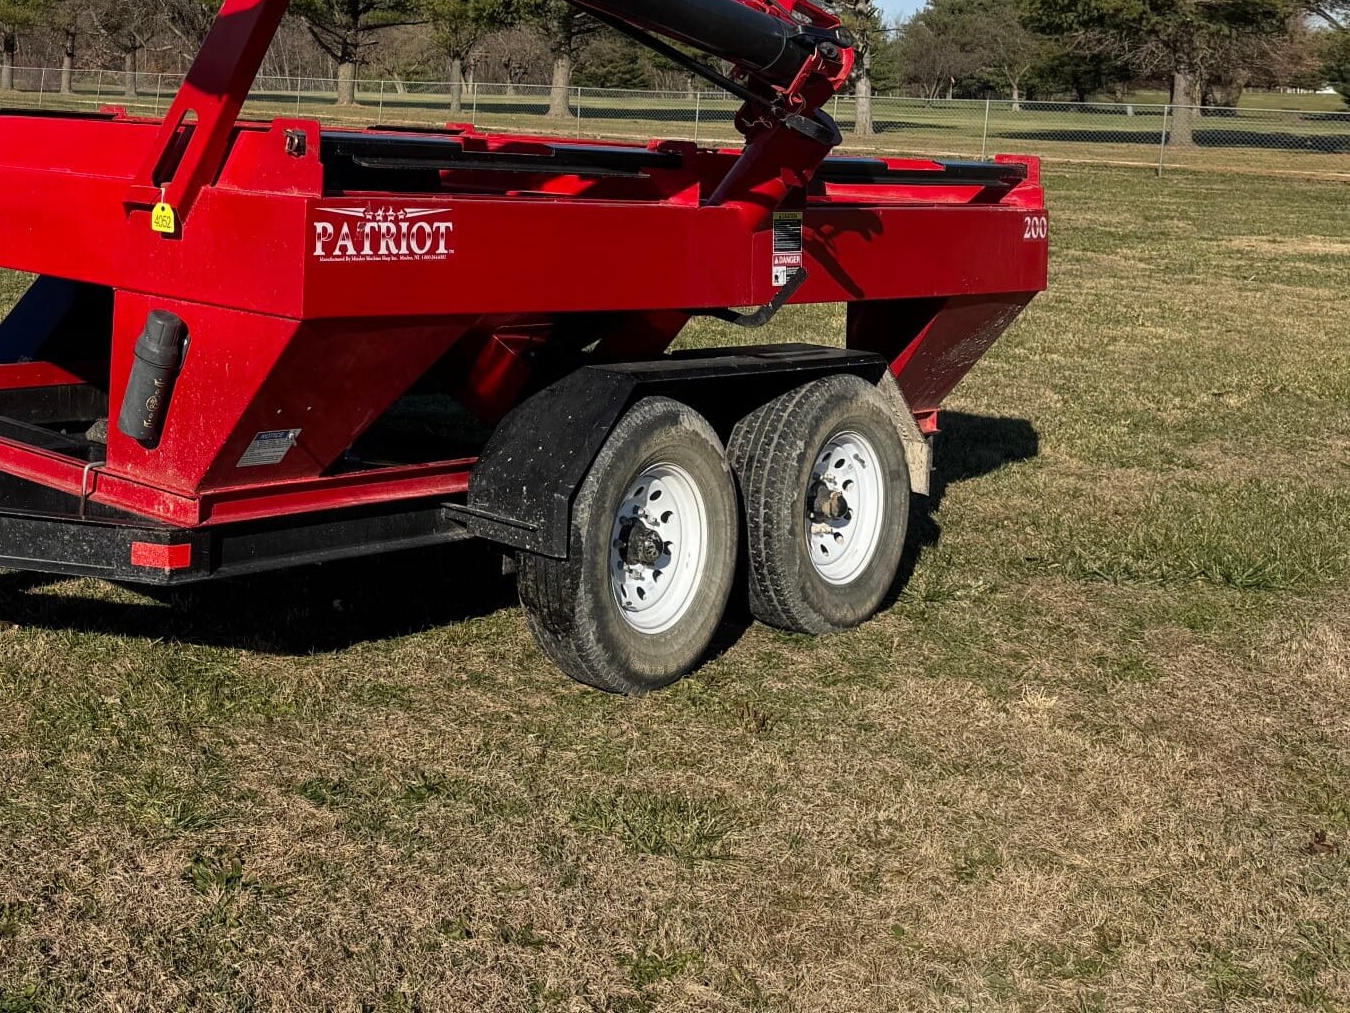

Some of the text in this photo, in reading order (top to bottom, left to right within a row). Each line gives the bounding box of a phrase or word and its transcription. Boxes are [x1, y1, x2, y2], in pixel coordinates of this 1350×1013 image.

[154, 214, 171, 228] 4052
[1023, 216, 1047, 238] 200
[313, 221, 453, 255] PATRIOT
[779, 255, 801, 264] DANGER
